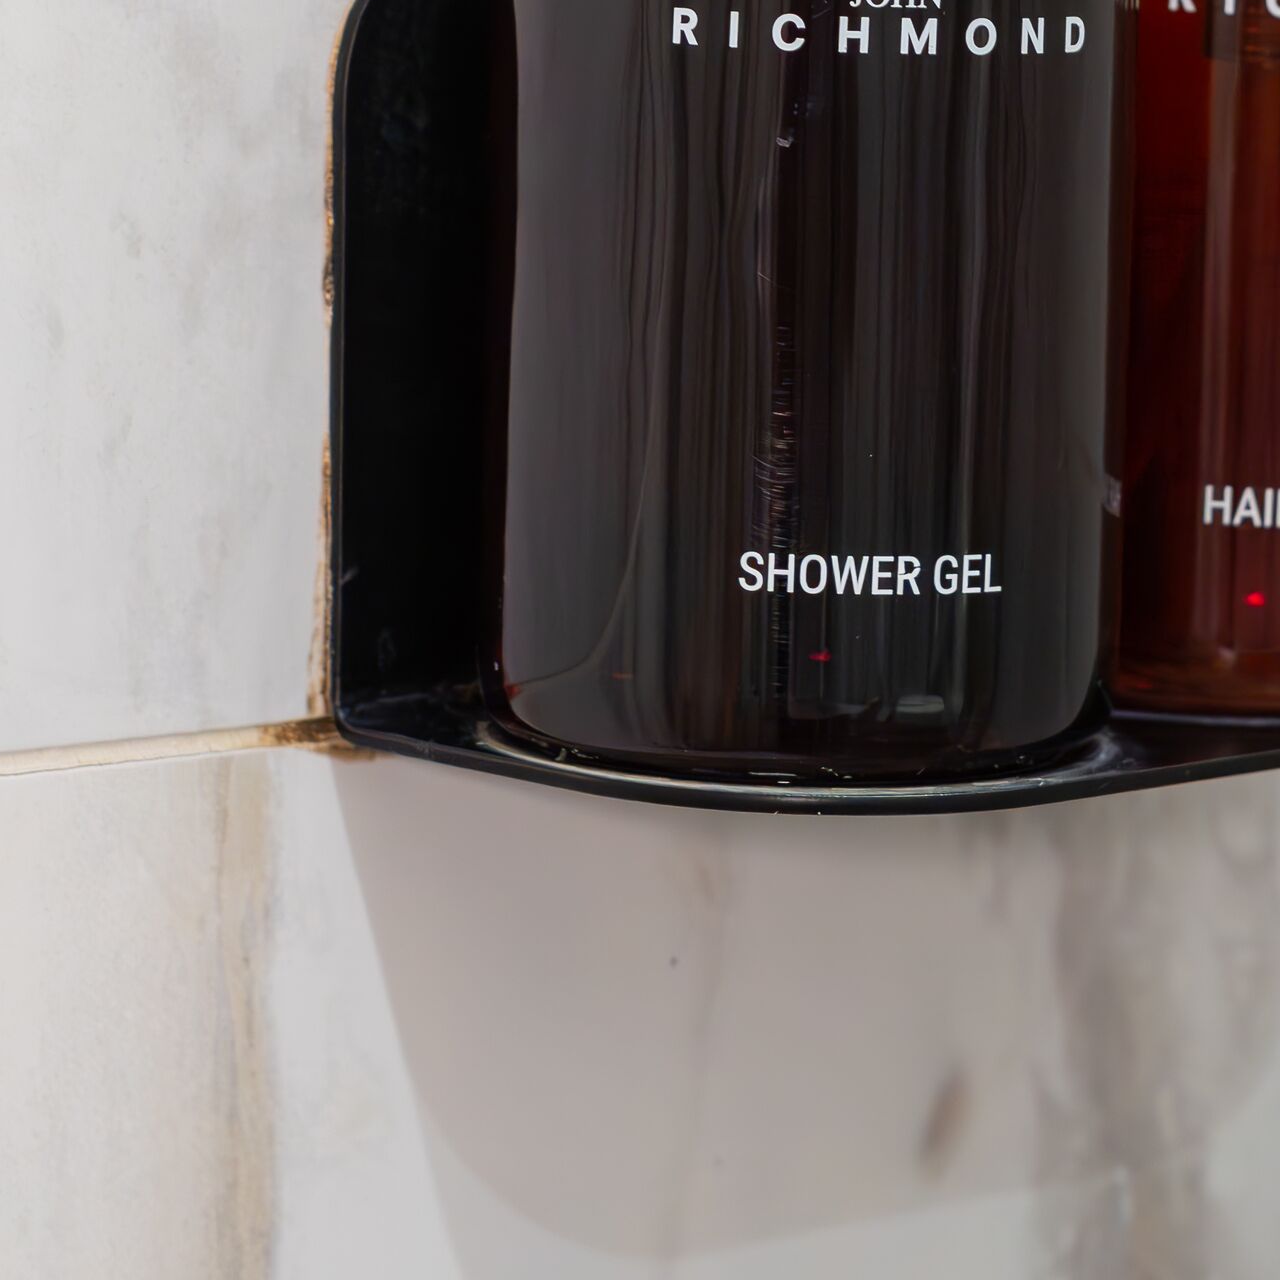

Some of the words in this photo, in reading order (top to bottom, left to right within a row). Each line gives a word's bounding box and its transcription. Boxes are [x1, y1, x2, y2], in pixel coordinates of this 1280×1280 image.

[671, 5, 1087, 57] RICHMOND
[737, 550, 922, 597] SHOWER
[932, 552, 1003, 596] GEL
